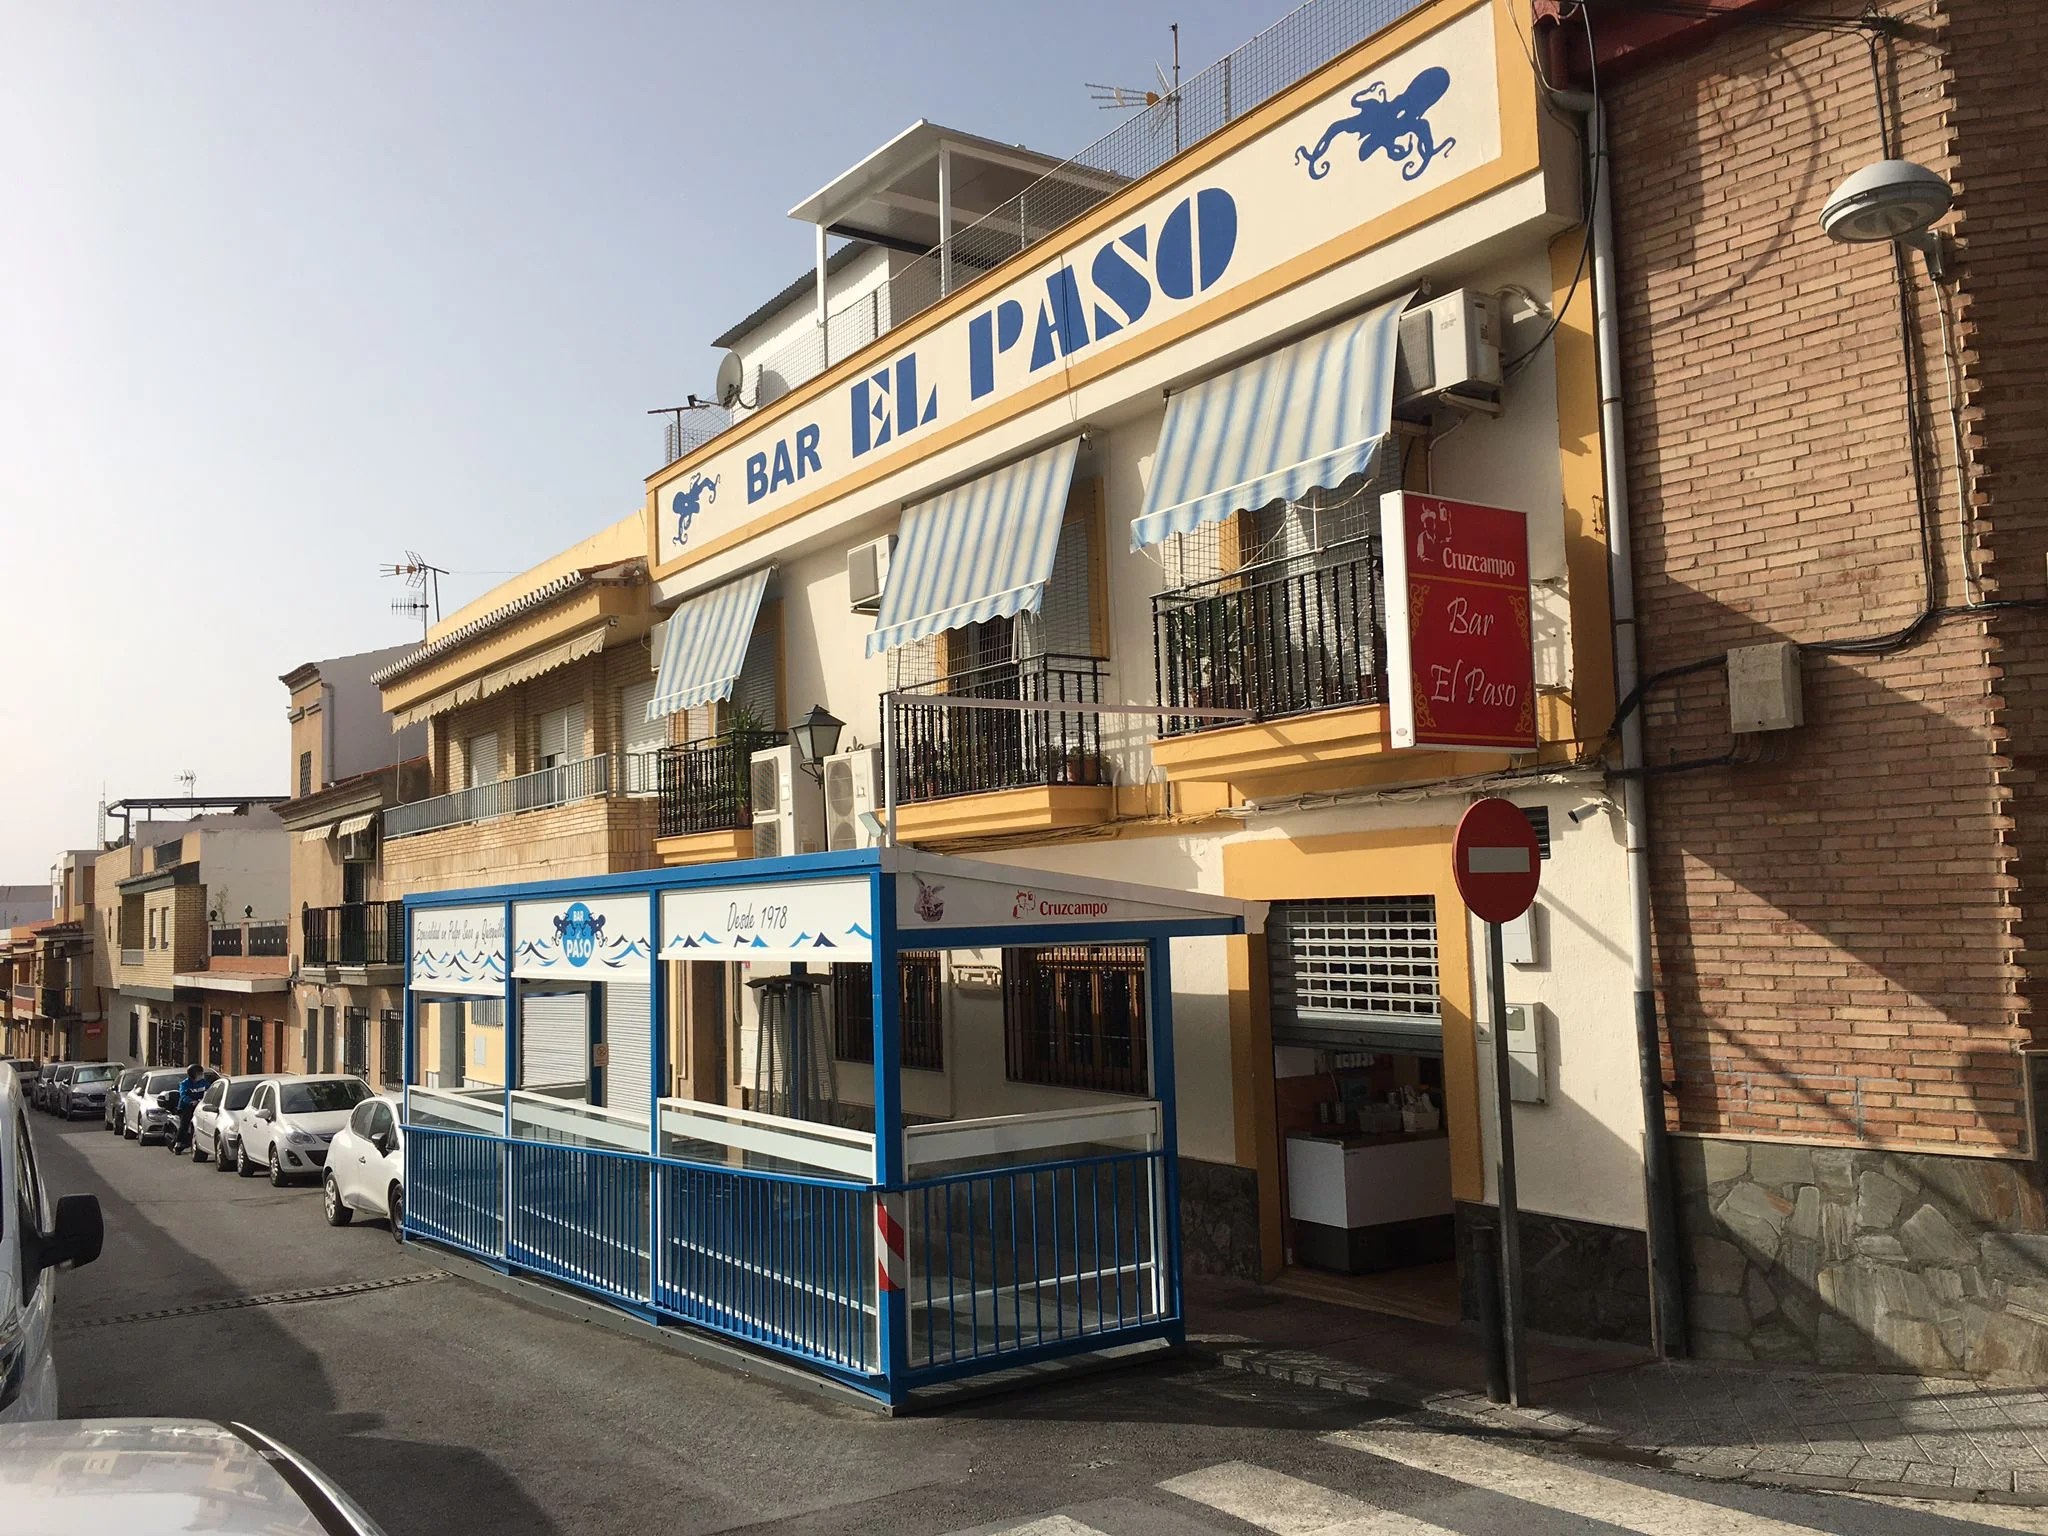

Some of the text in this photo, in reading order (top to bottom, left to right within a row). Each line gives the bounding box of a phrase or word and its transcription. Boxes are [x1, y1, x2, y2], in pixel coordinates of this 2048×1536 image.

[746, 187, 1237, 504] BAR EL PASO
[1443, 547, 1515, 578] Cruzcampo
[1447, 597, 1494, 637] Bar
[1430, 658, 1517, 707] El Paso
[573, 910, 584, 922] BAR
[727, 902, 788, 932] Desde 1978
[1039, 901, 1108, 917] Cruzcampo
[566, 938, 592, 958] PASO
